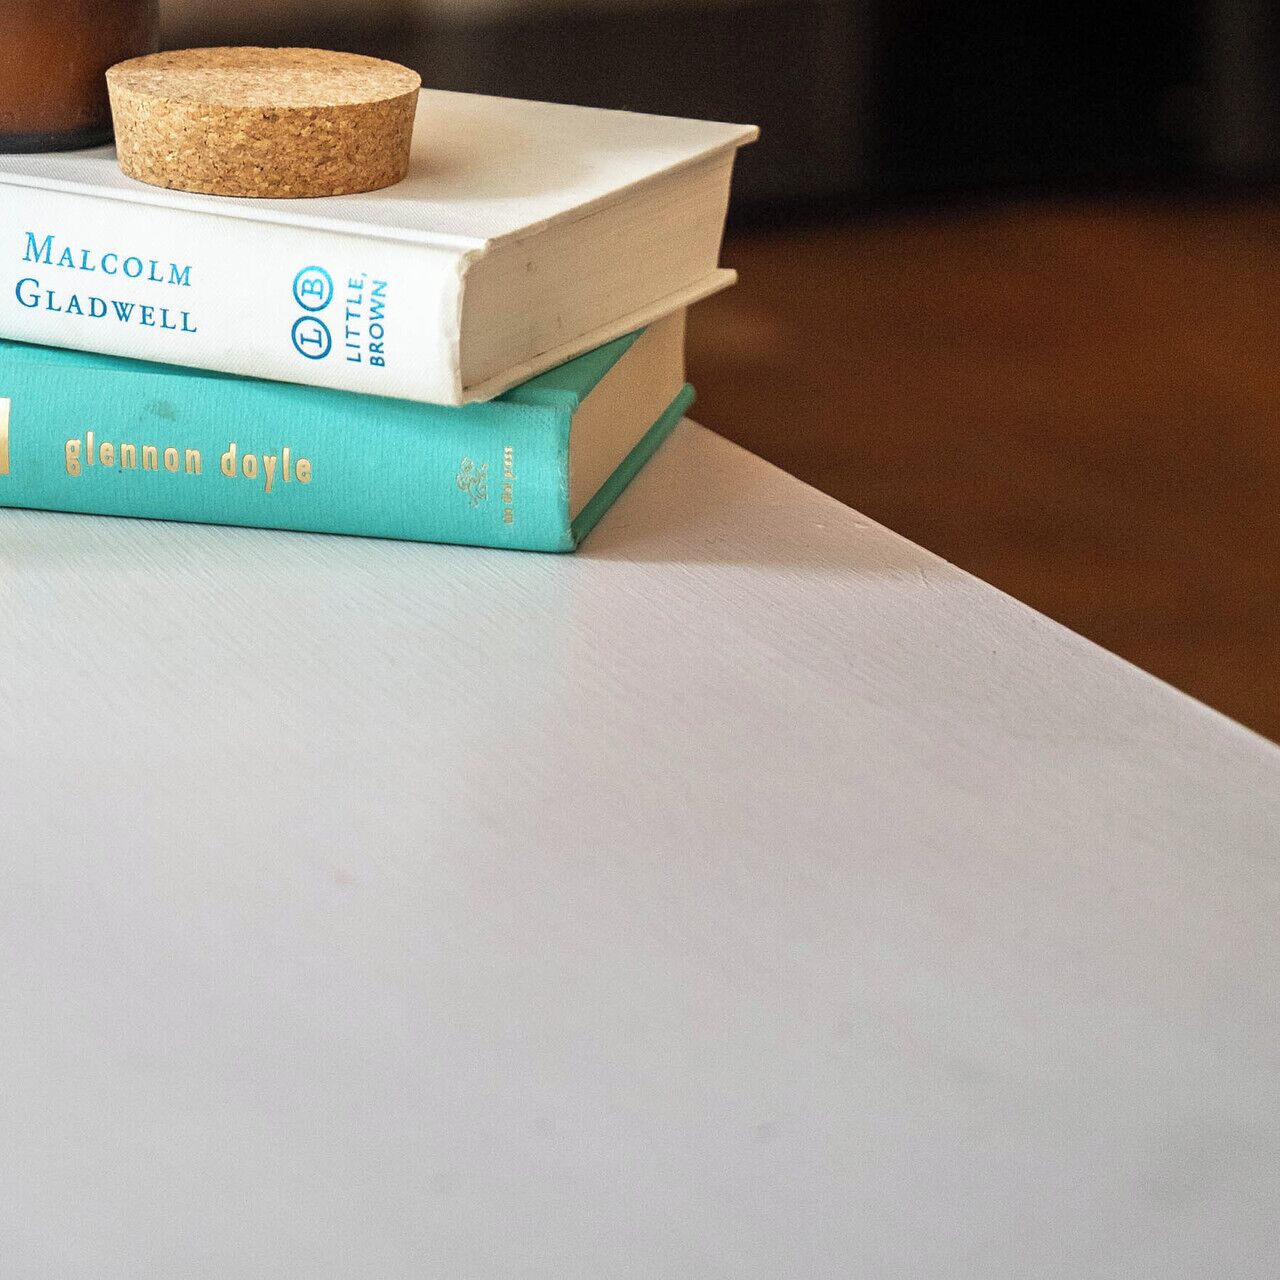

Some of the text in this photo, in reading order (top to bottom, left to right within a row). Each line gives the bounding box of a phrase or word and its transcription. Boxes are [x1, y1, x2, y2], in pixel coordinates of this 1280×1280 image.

[22, 231, 193, 287] MALCOLM
[15, 277, 198, 333] GLADWELL
[345, 272, 368, 363] LITTLE,
[369, 279, 388, 368] BROWN
[64, 430, 313, 494] glennon doyle
